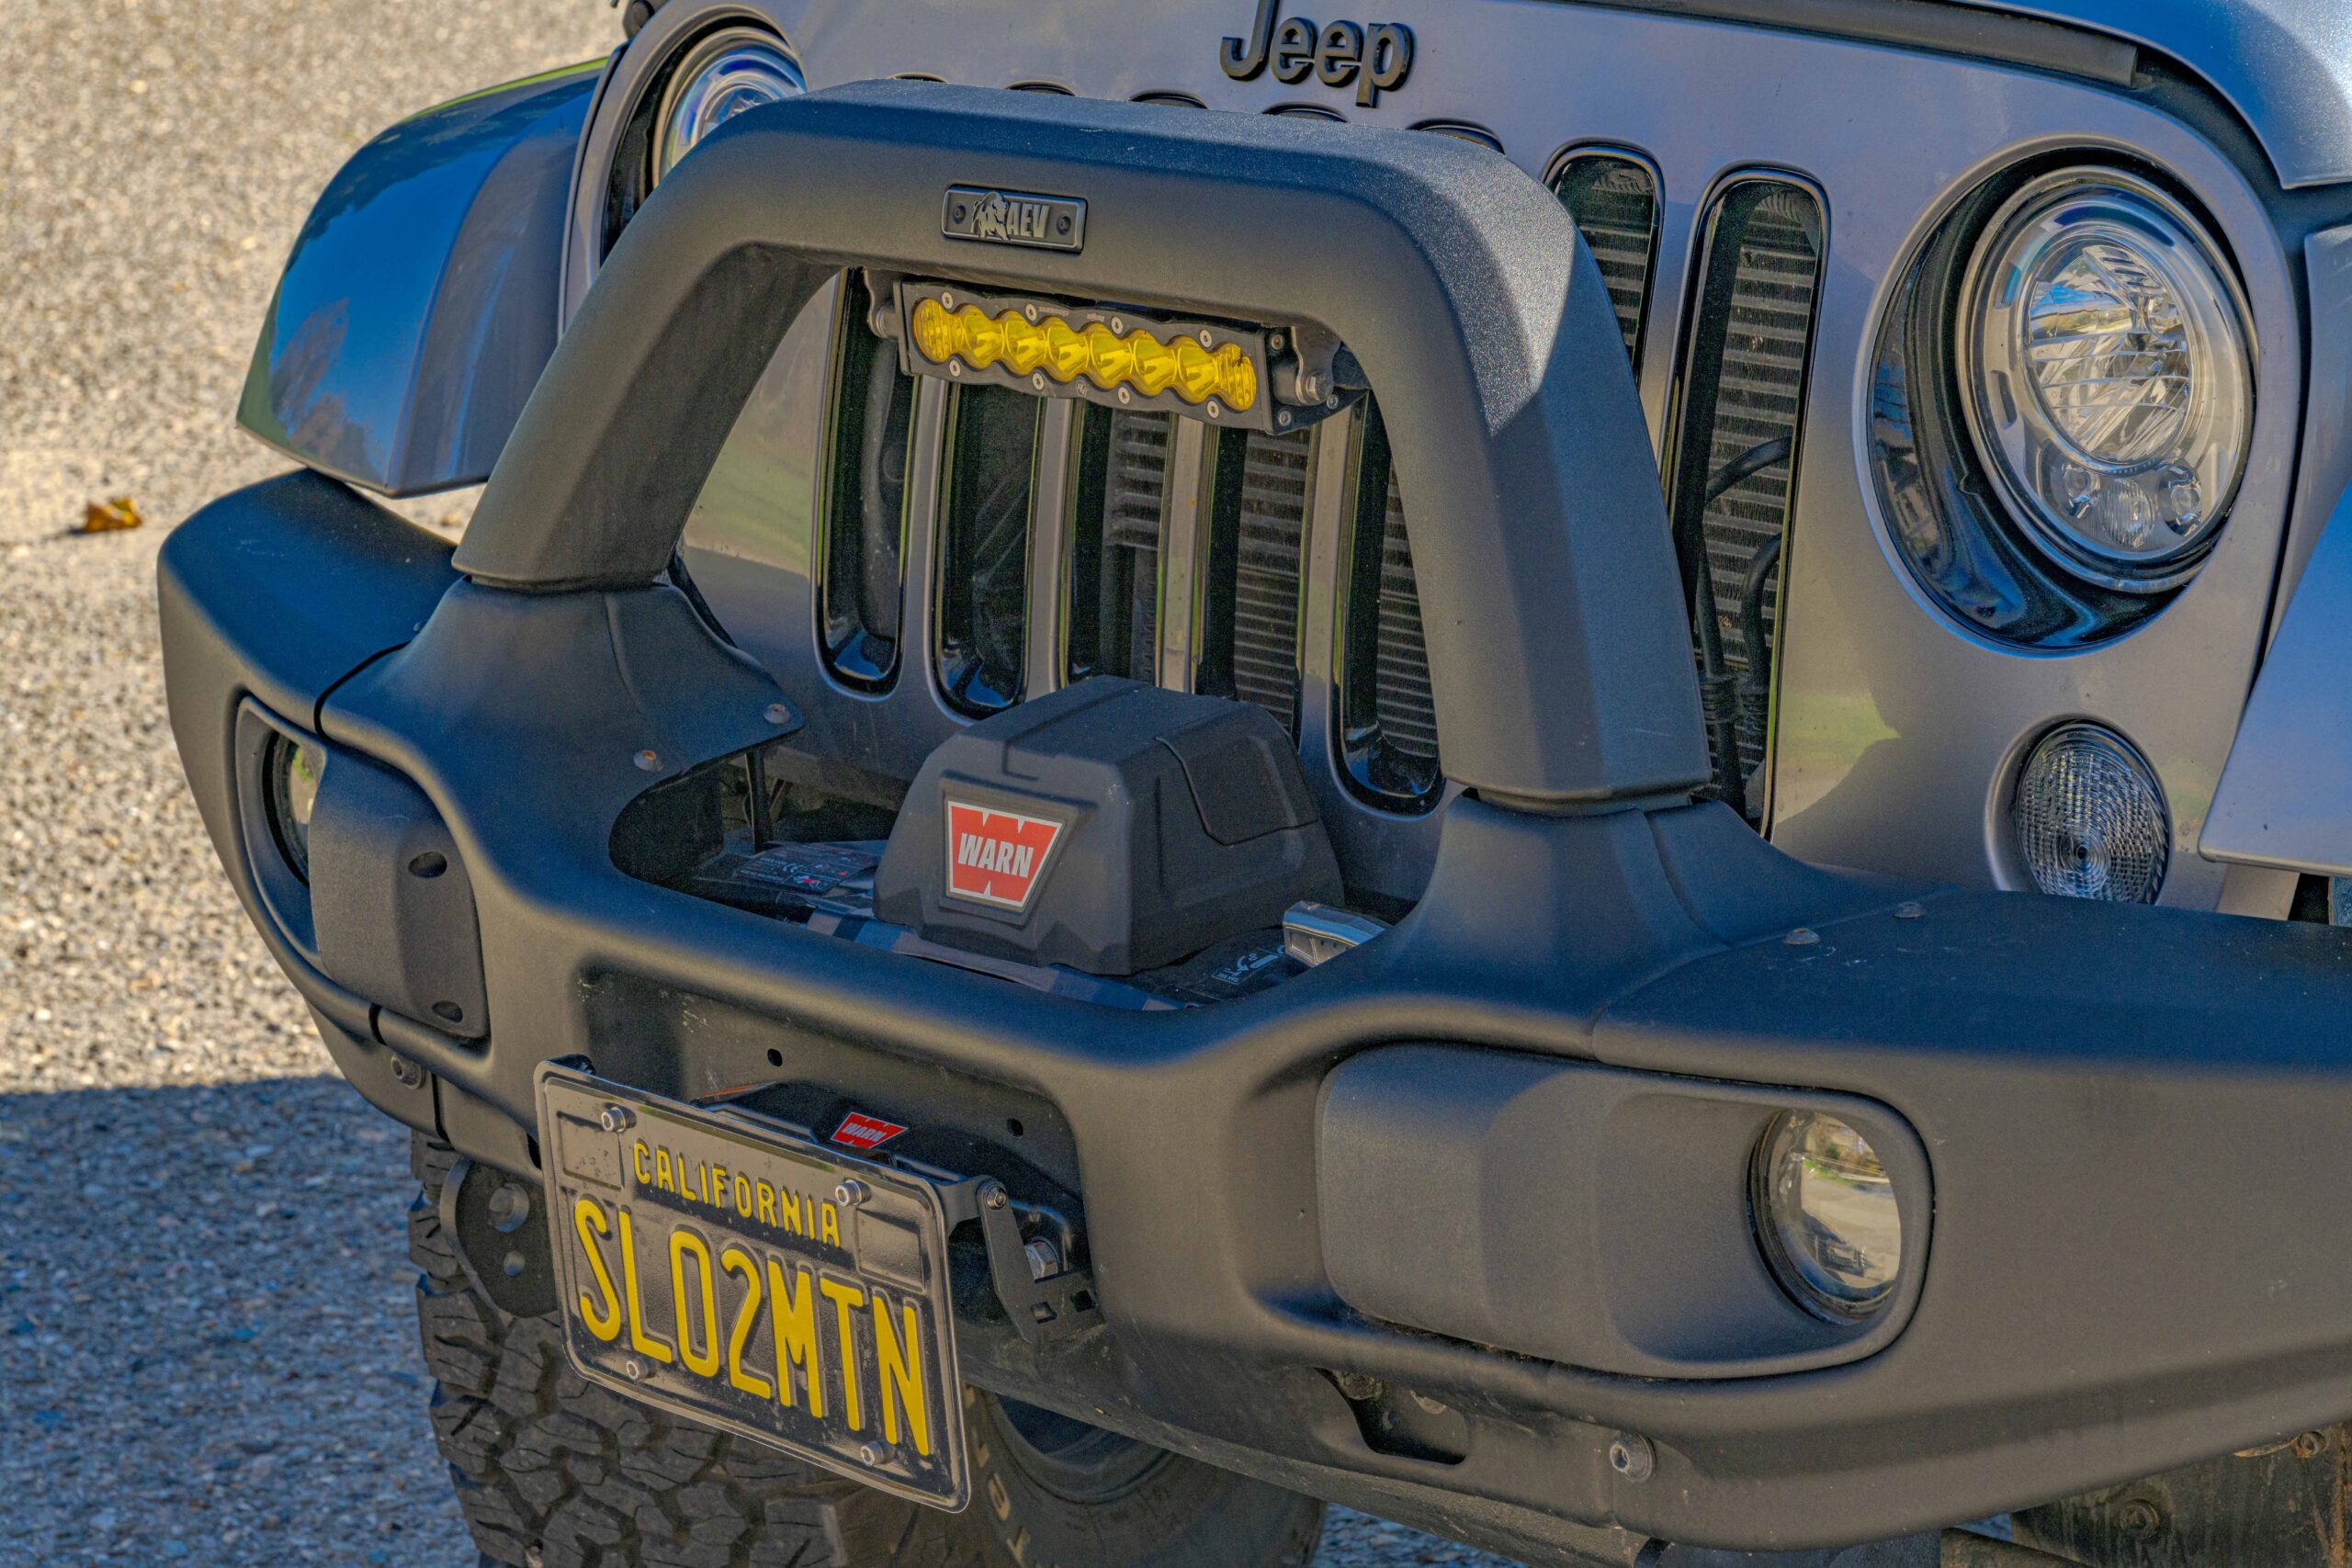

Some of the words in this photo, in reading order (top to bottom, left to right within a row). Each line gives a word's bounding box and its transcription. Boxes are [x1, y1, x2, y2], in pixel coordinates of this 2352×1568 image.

[1219, 0, 1415, 107] Jeep
[1005, 202, 1051, 238] AEV
[958, 832, 1034, 878] WARN
[842, 1122, 888, 1143] WARN
[633, 1142, 842, 1247] CALIFORNIA
